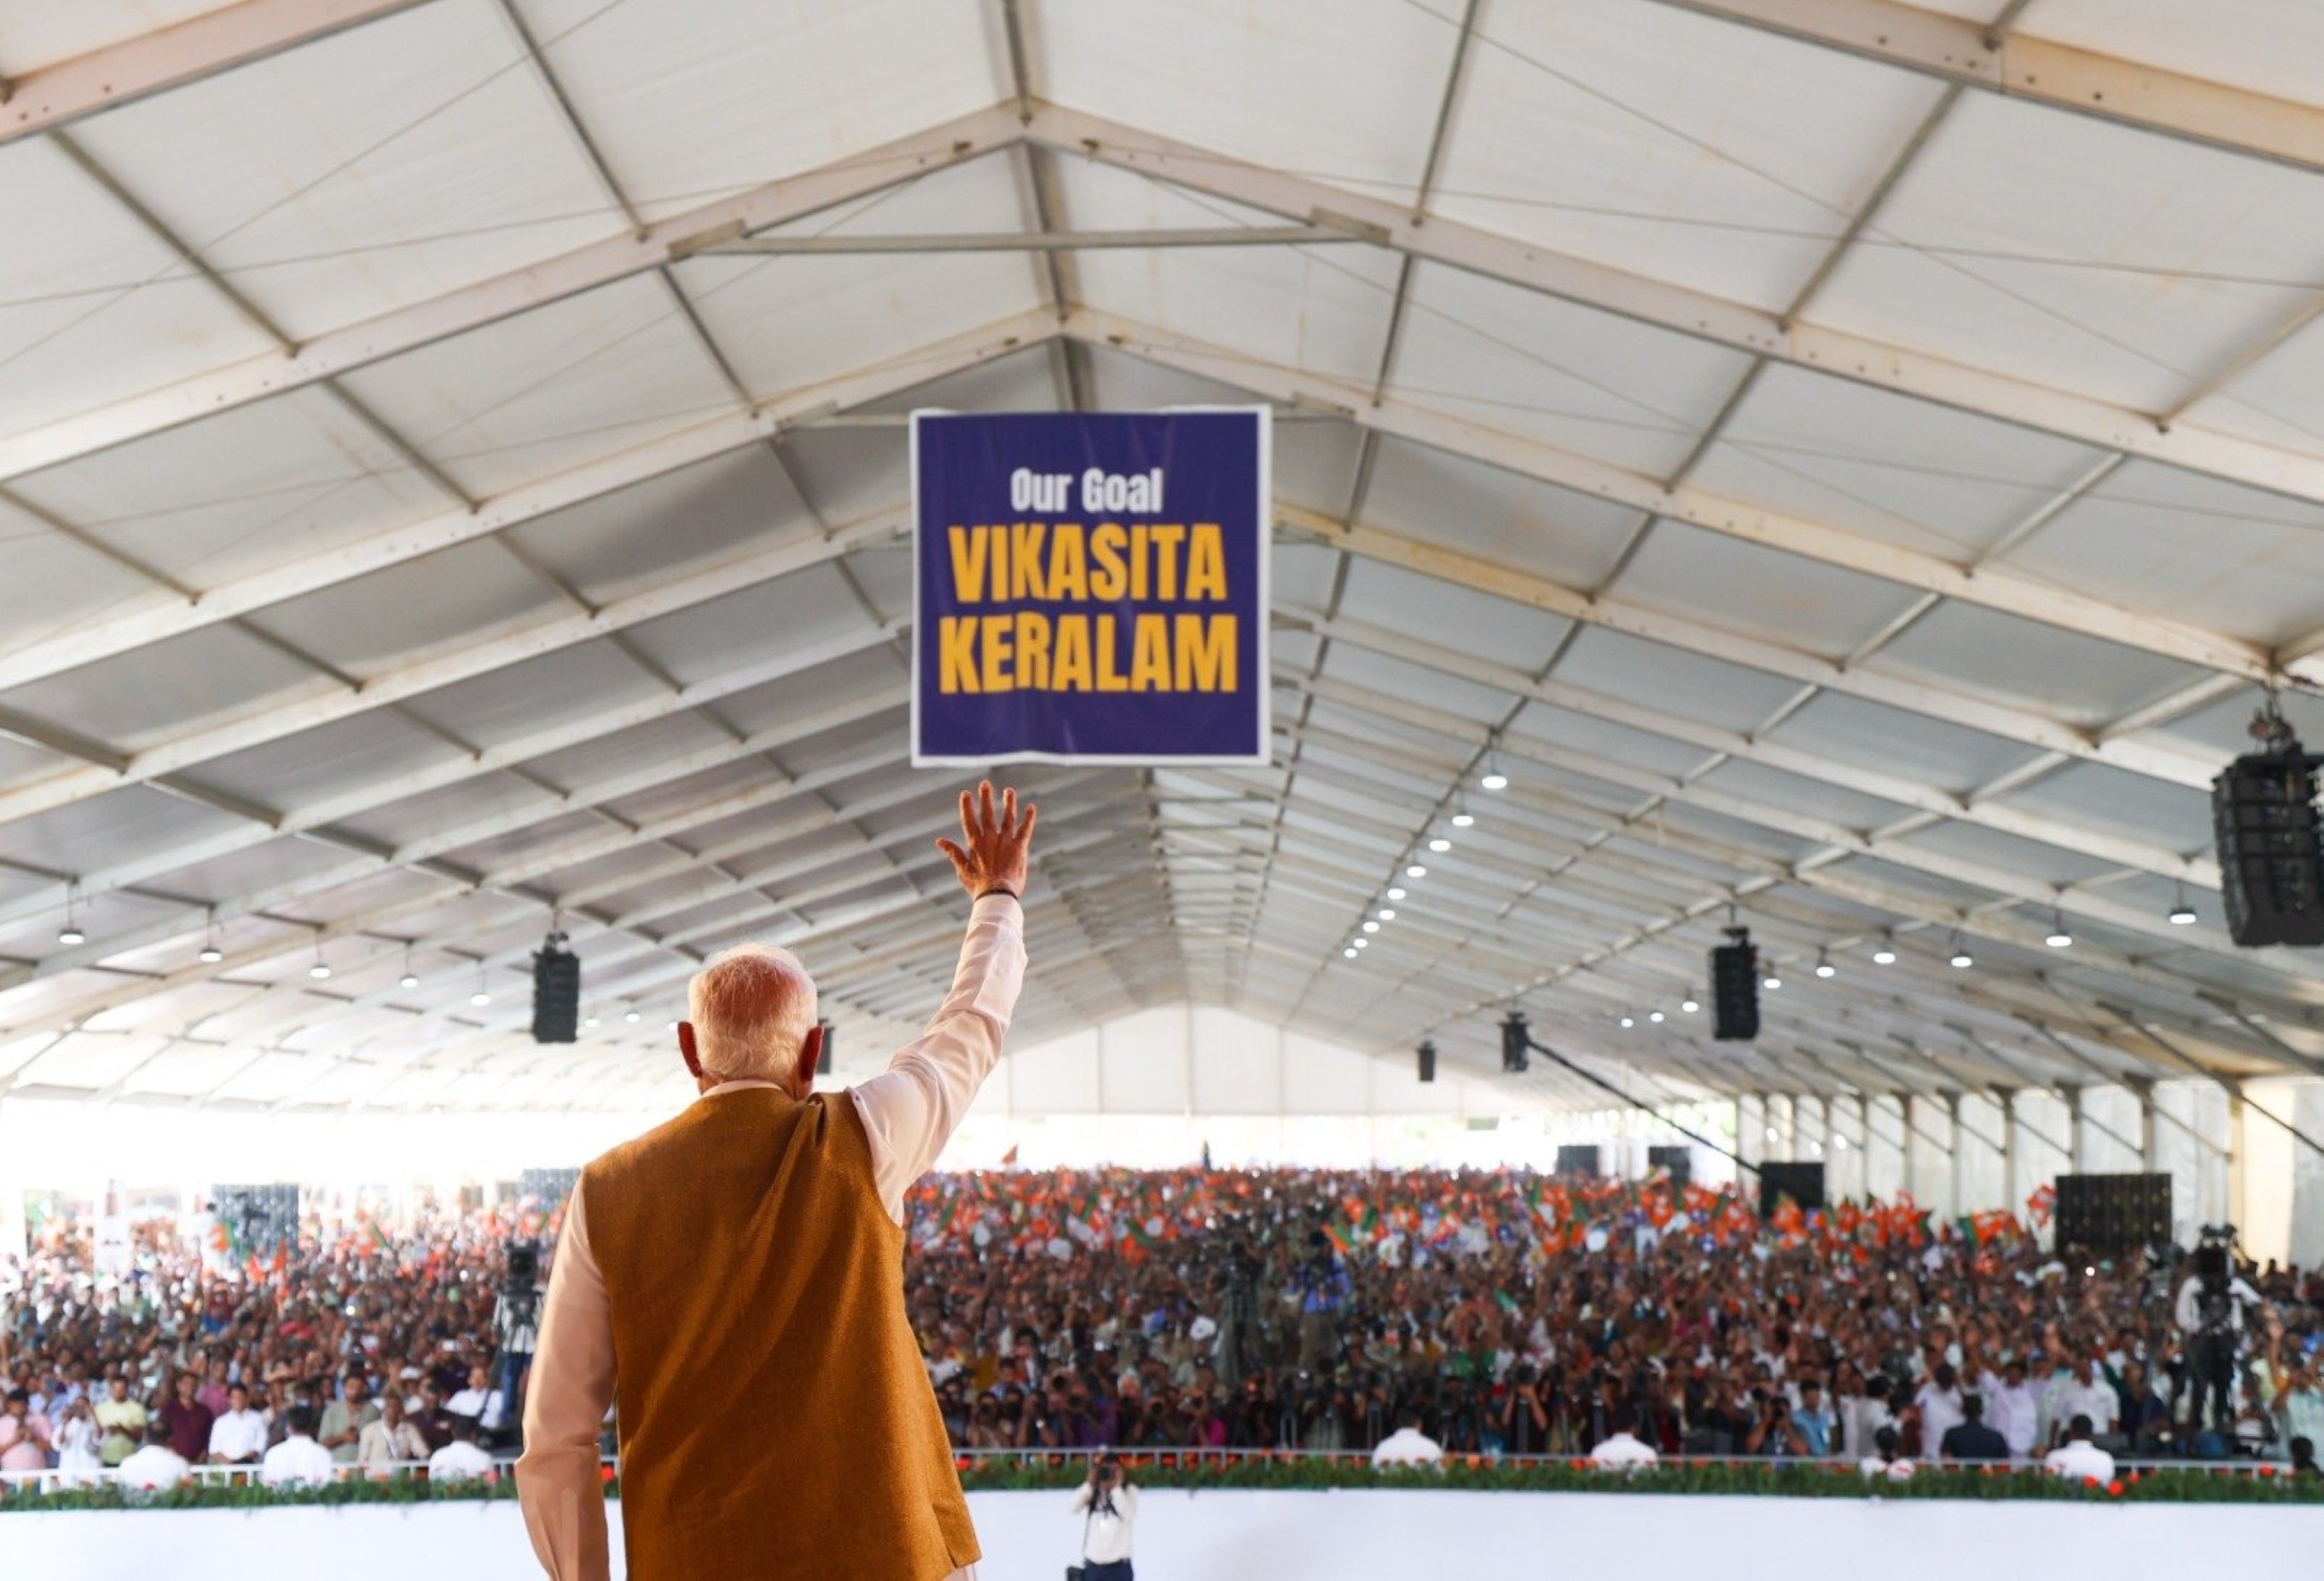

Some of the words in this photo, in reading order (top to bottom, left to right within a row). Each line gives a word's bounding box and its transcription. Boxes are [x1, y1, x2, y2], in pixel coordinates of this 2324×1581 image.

[1011, 467, 1073, 512] Our
[1082, 467, 1163, 513] Goal
[947, 522, 1228, 603] VIKASITA
[939, 611, 1238, 694] KERALAM
